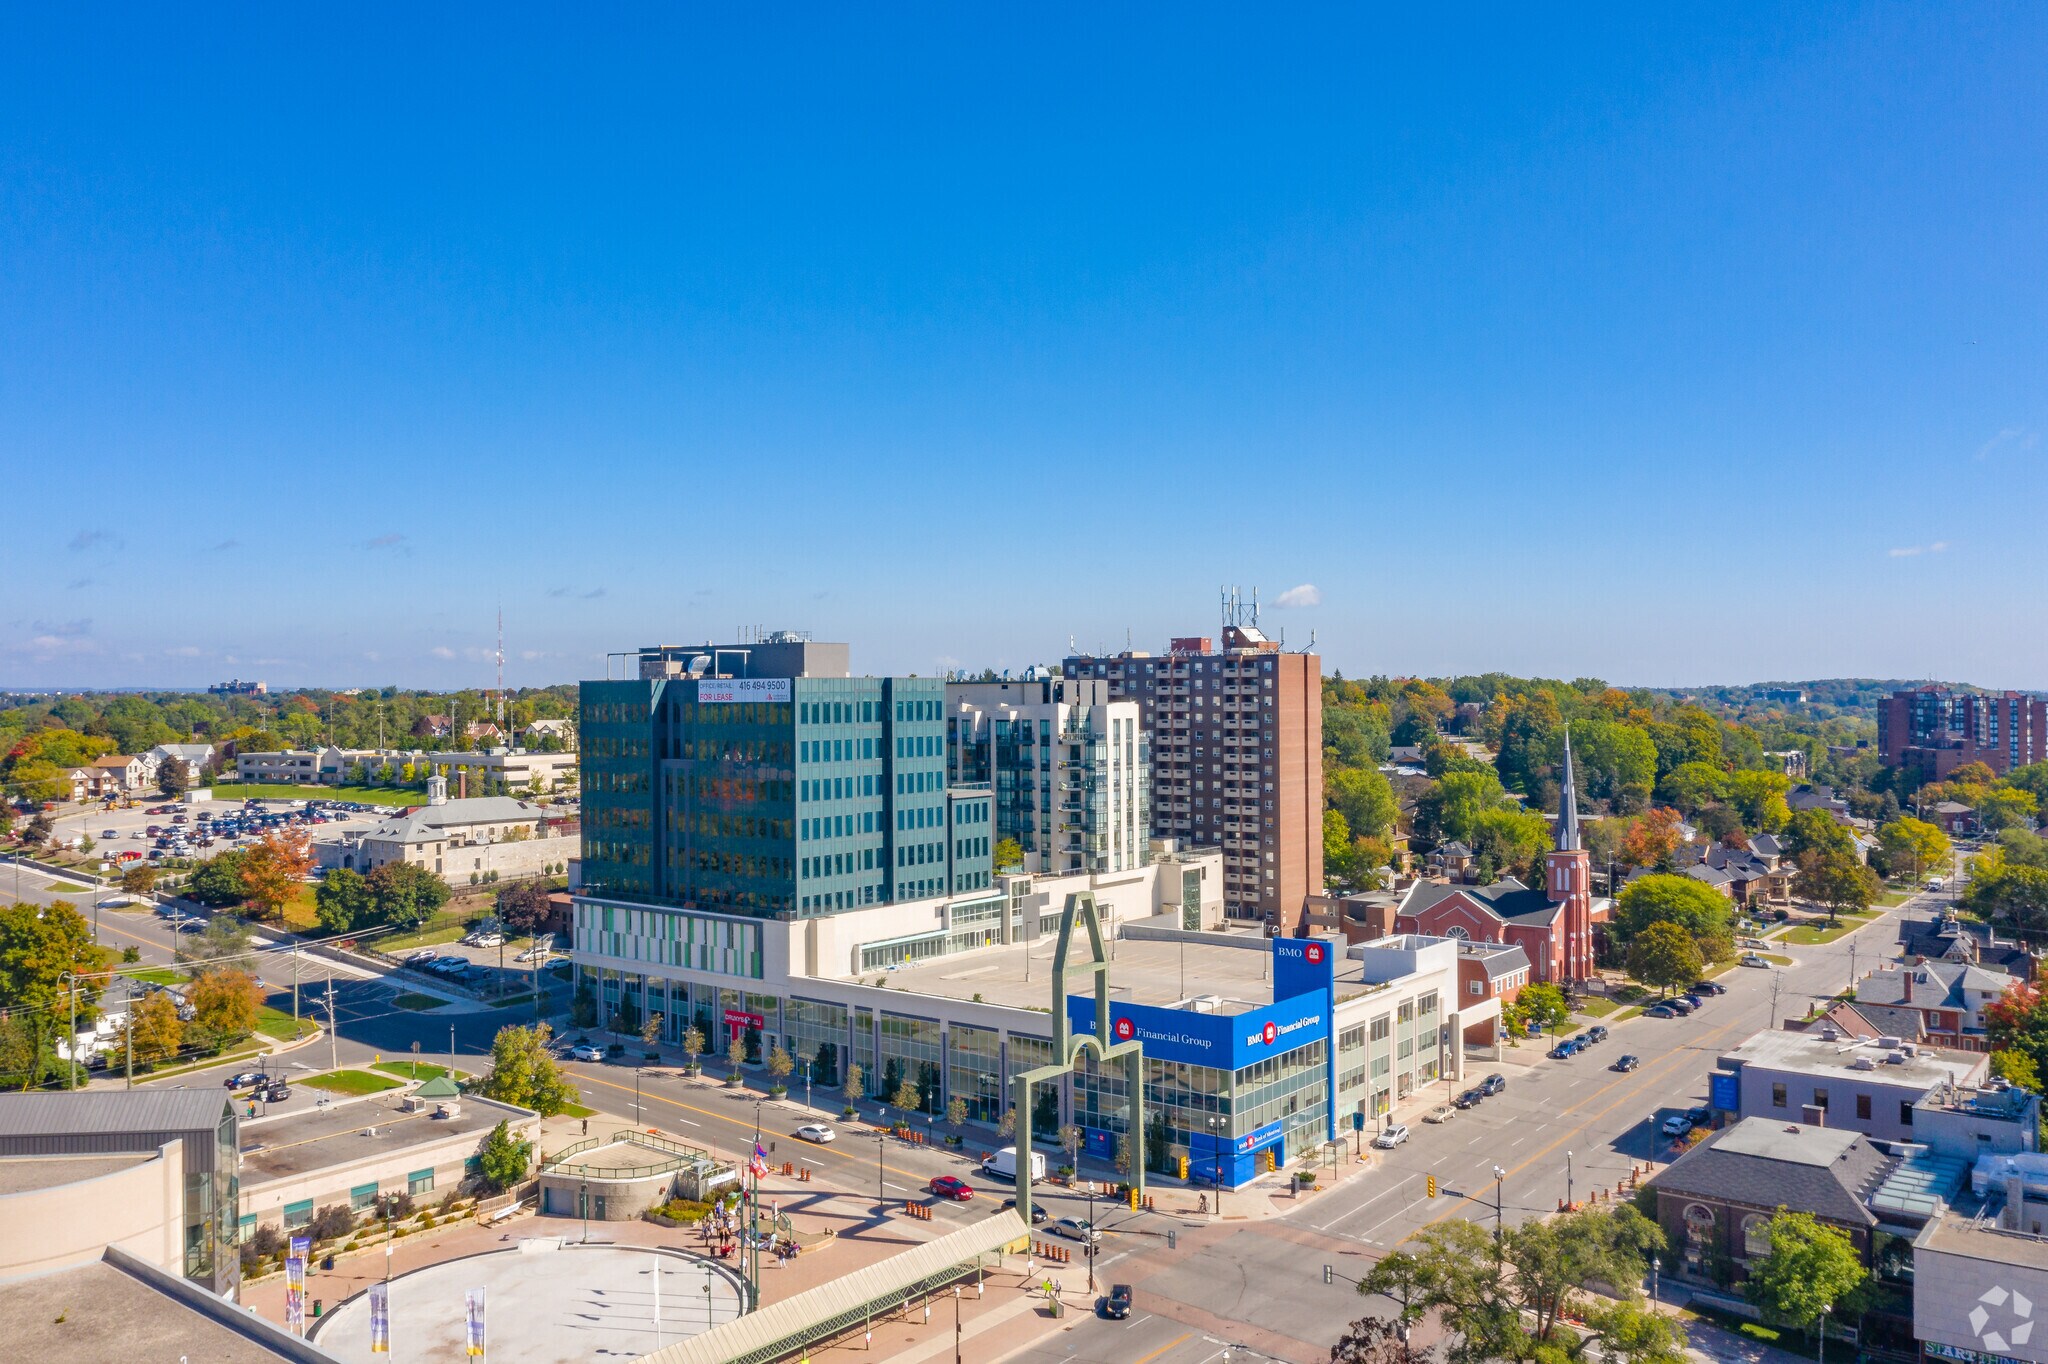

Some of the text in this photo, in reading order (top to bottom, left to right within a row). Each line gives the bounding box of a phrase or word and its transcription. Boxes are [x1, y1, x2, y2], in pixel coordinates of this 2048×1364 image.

[739, 681, 786, 690] 416 494 9500
[700, 693, 733, 701] FOR LEASE
[1278, 947, 1302, 958] BMO
[1247, 1013, 1320, 1047] BMO Financial Group
[1136, 1027, 1212, 1050] Financial Group
[1925, 1341, 1976, 1361] START
